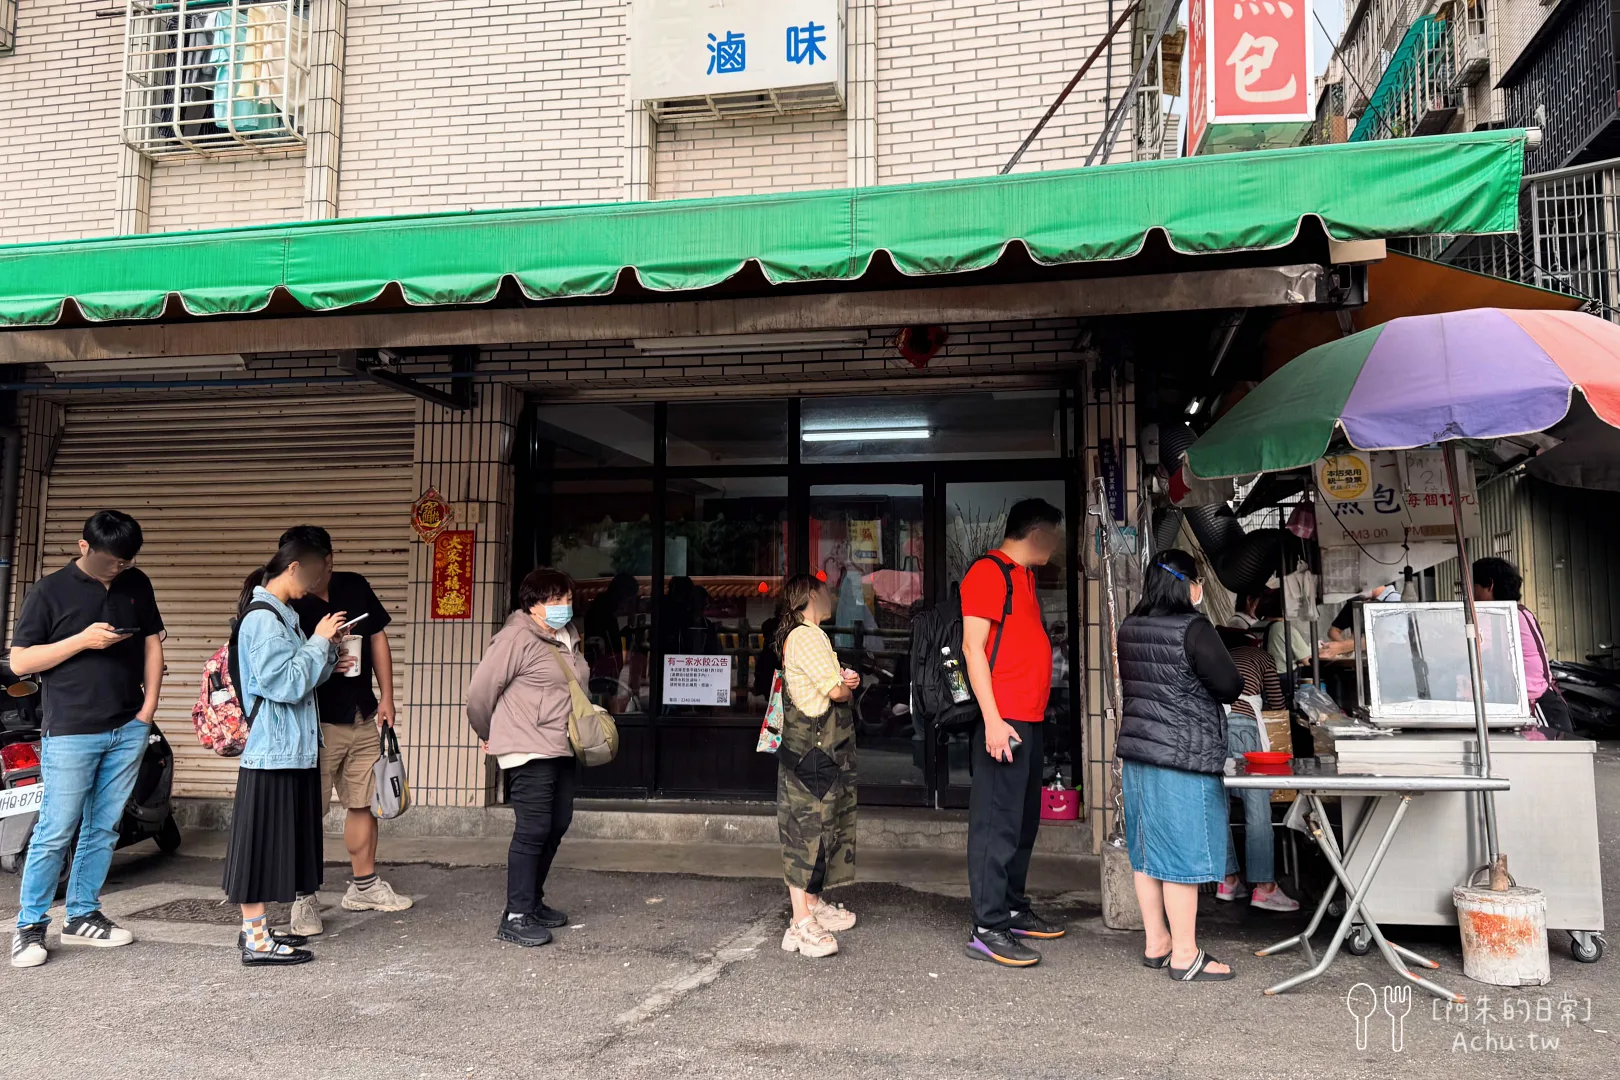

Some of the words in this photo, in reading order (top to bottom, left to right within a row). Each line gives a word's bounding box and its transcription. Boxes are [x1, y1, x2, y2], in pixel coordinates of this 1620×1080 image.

[706, 20, 827, 76] 滷味
[1326, 468, 1362, 477] 本店免用
[1327, 476, 1362, 485] 統一發票
[668, 657, 728, 667] 有一家水餃公告
